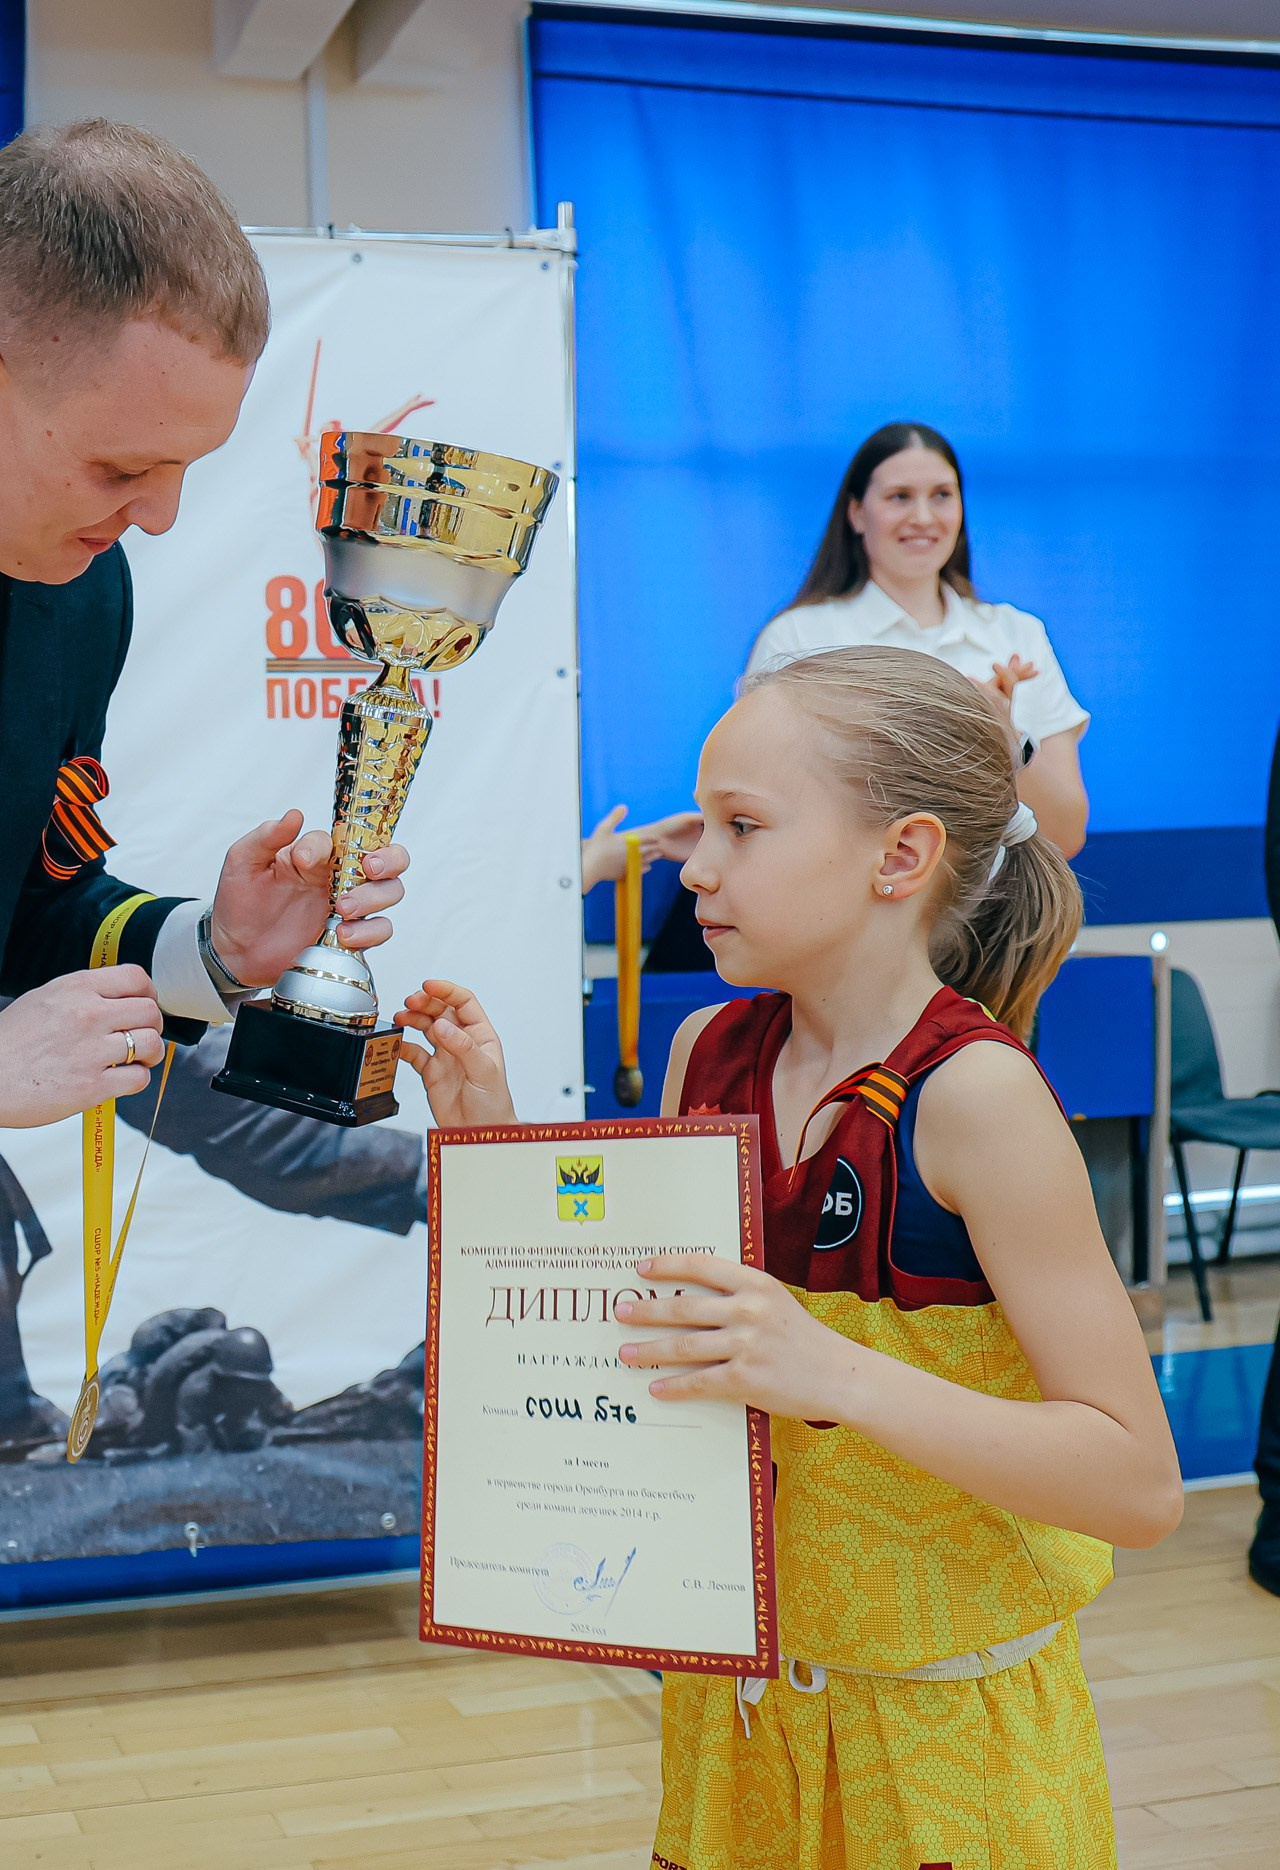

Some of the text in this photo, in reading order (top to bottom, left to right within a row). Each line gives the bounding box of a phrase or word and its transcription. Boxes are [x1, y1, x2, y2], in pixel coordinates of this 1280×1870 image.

[266, 678, 440, 719] ПОБЕ!
[460, 1244, 716, 1258] КОМИТЕТ ПО ФИЗИЧЕСКОЙ КУЛЬТУРЕ И СПОРТУ
[485, 1259, 579, 1270] АДМИНИСТРАЦИИ
[581, 1259, 622, 1270] ГОРОДА
[486, 1286, 685, 1328] ДИПЛО
[517, 1354, 661, 1369] НАГРАЖДАЕ
[482, 1404, 519, 1416] Команда
[582, 1459, 609, 1468] место
[494, 1478, 542, 1491] первенстве
[544, 1484, 573, 1494] города
[575, 1484, 625, 1498] Оренбурга
[641, 1488, 696, 1503] баскетболу
[516, 1501, 542, 1512] среди
[544, 1504, 577, 1515] команд
[578, 1507, 618, 1518] девушек
[620, 1507, 642, 1517] 2014
[450, 1556, 550, 1577] Председатель комитета
[682, 1578, 746, 1592] С.В. Леонов
[570, 1622, 590, 1633] 2025
